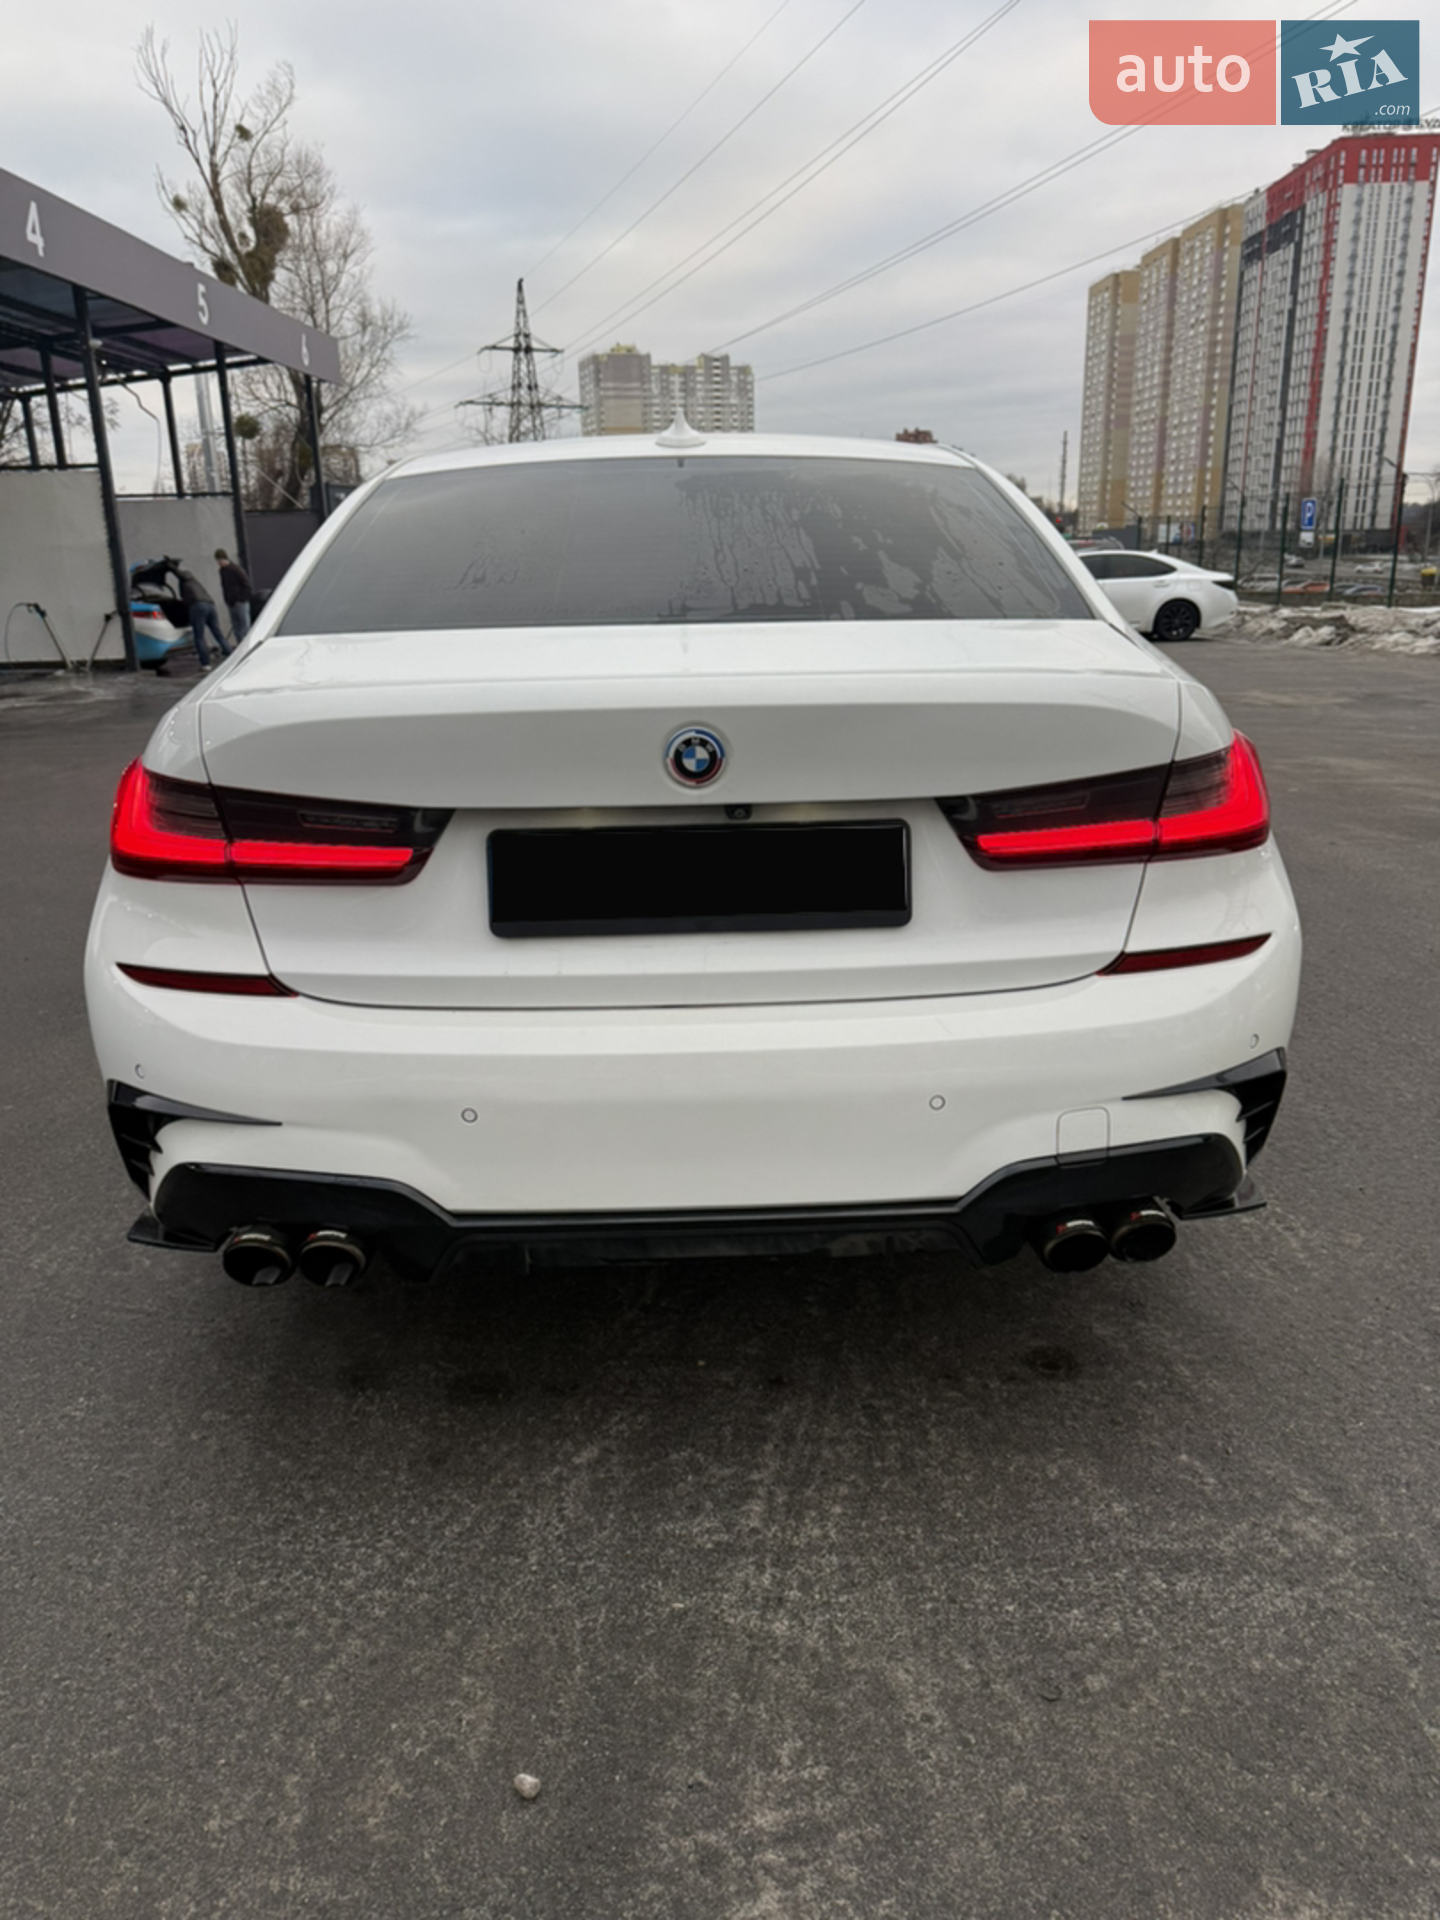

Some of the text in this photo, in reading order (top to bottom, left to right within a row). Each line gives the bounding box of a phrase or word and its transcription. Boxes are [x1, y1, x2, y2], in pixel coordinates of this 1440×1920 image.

[26, 200, 45, 257] 4
[197, 283, 209, 325] 5
[301, 333, 310, 367] 6
[1304, 503, 1315, 524] P
